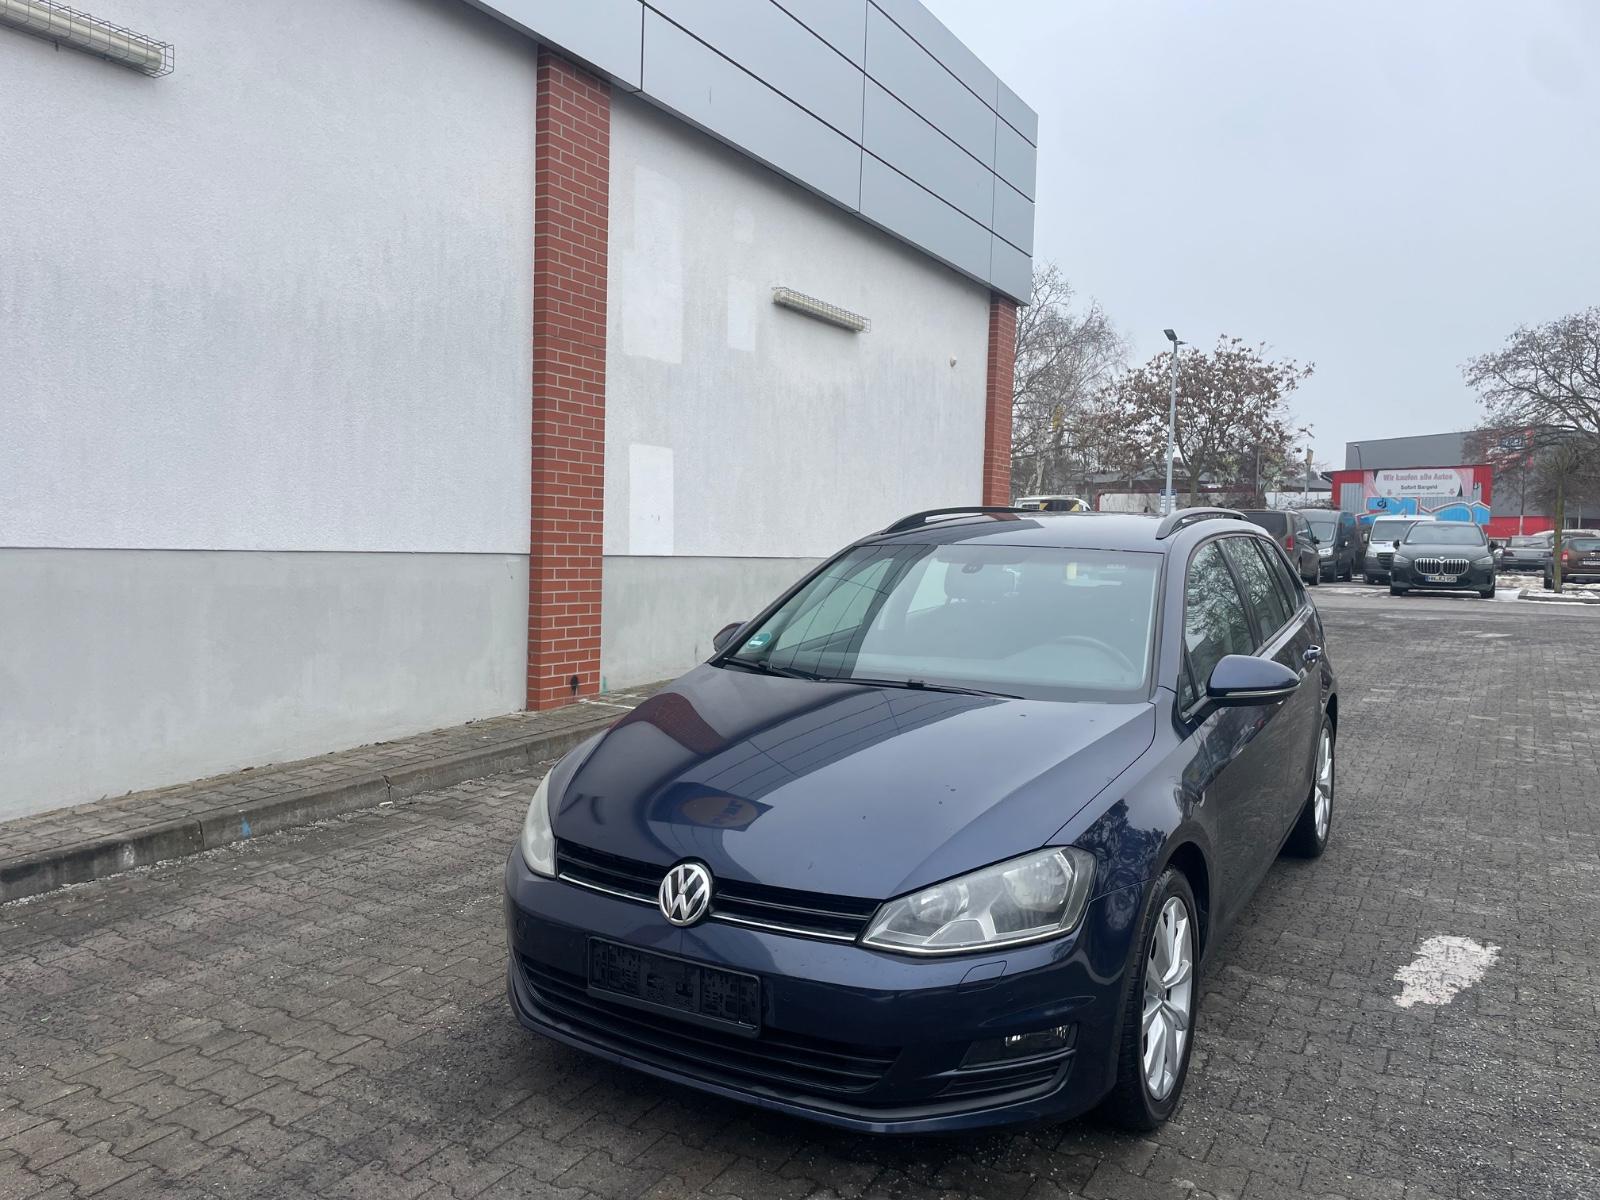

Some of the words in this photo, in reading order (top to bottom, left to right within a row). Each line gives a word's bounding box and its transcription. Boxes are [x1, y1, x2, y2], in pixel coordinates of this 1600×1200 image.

[1383, 473, 1394, 481] Wir
[1395, 473, 1418, 481] kaufen
[1420, 473, 1432, 481] alle
[1433, 472, 1453, 480] Autos
